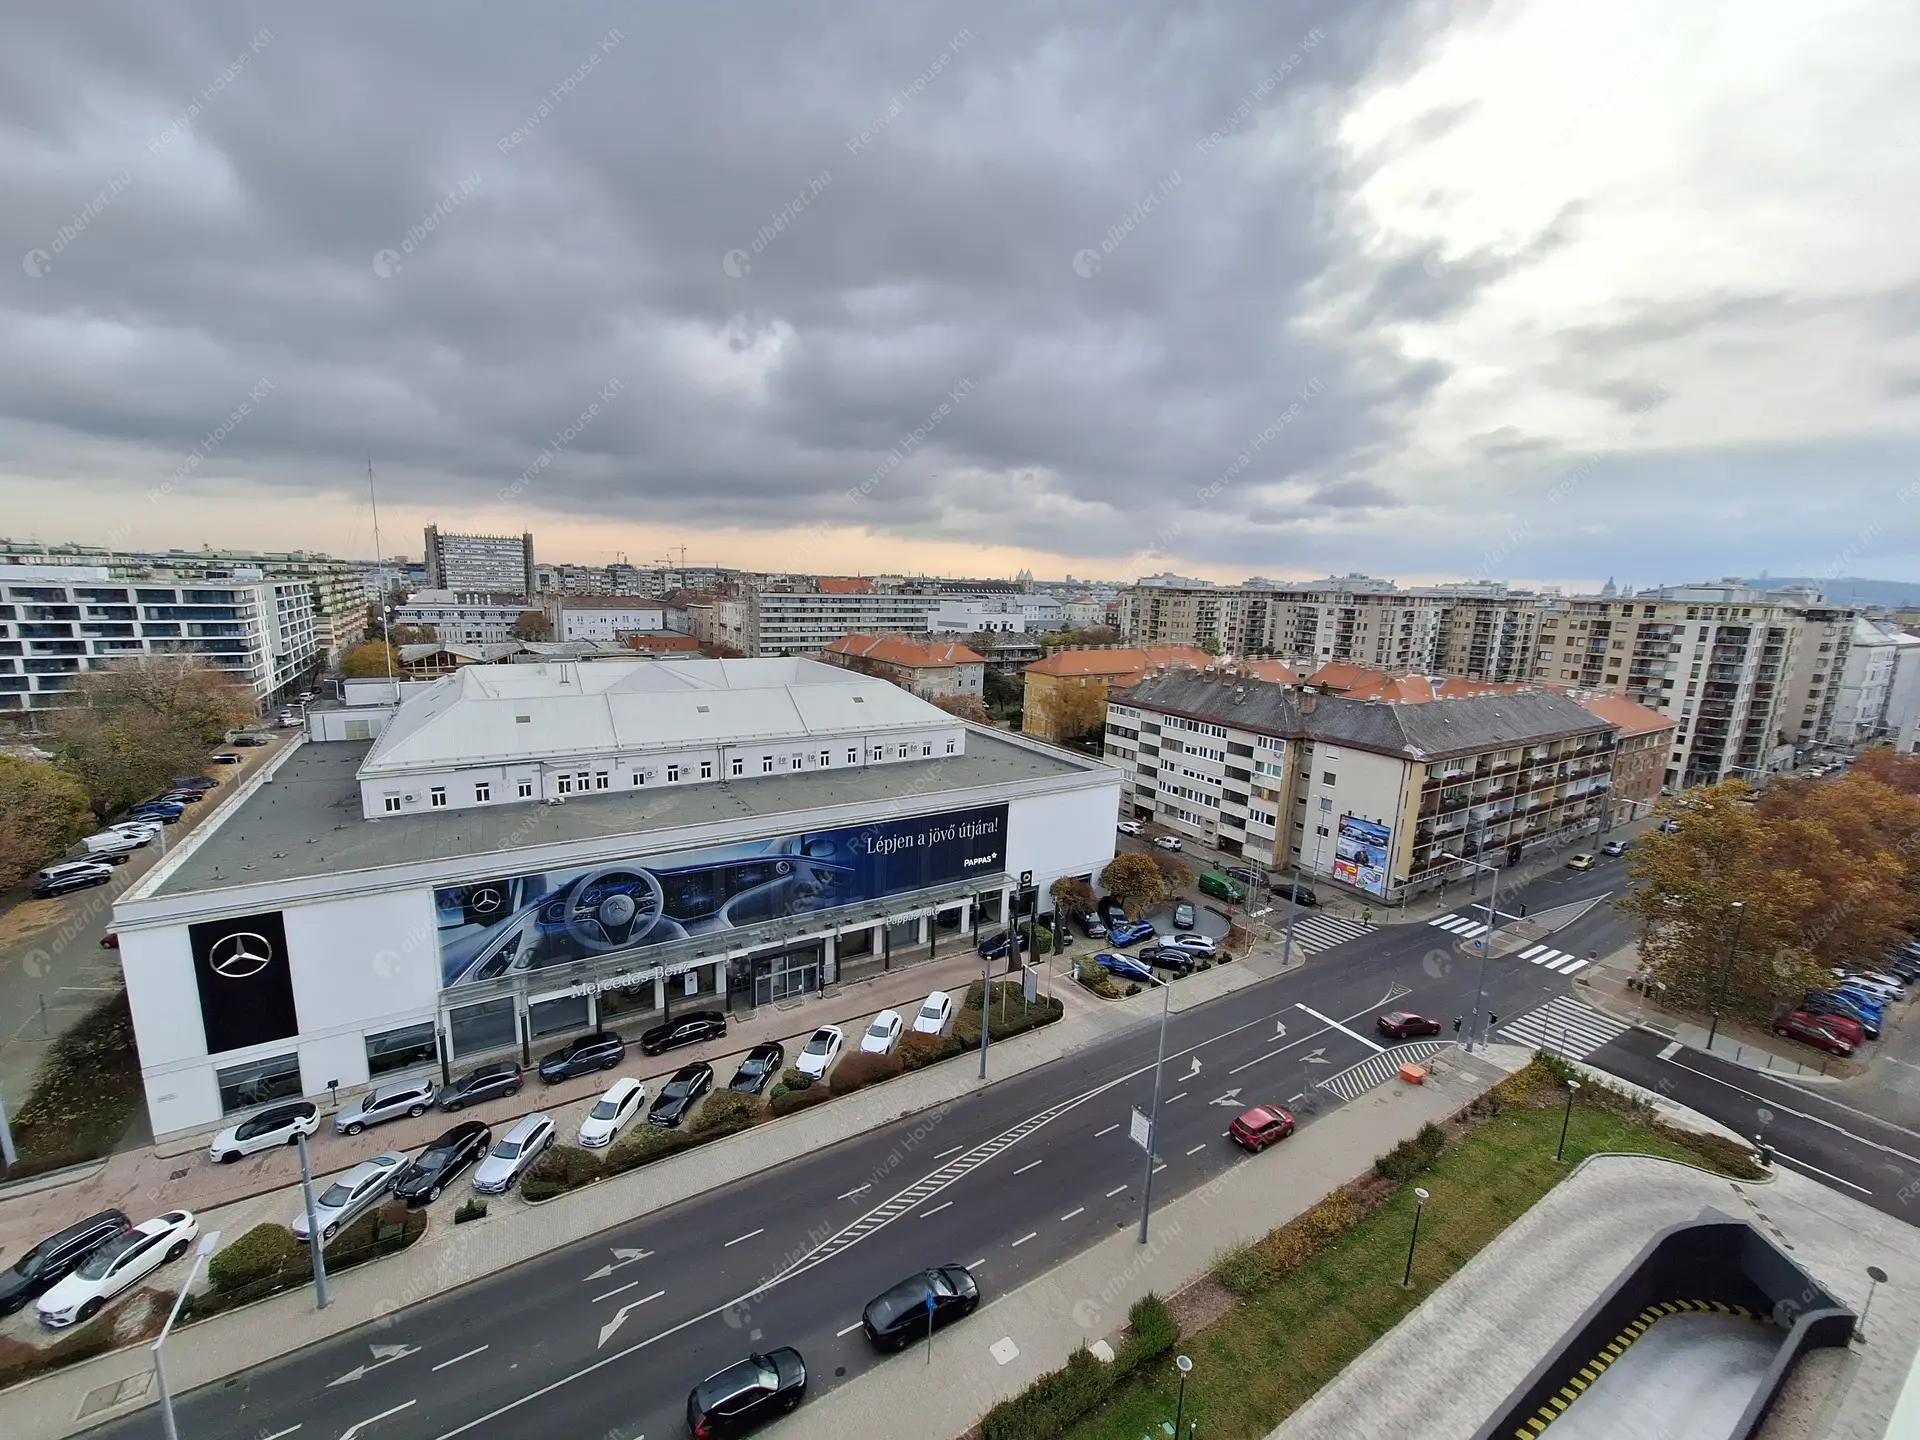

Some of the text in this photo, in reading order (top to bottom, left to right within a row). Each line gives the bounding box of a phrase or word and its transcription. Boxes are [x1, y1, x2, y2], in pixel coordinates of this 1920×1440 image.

[867, 817, 998, 855] Lépjen a jövő útjára!
[964, 857, 992, 868] PAPPAS
[570, 963, 690, 999] Mercedes-Benz
